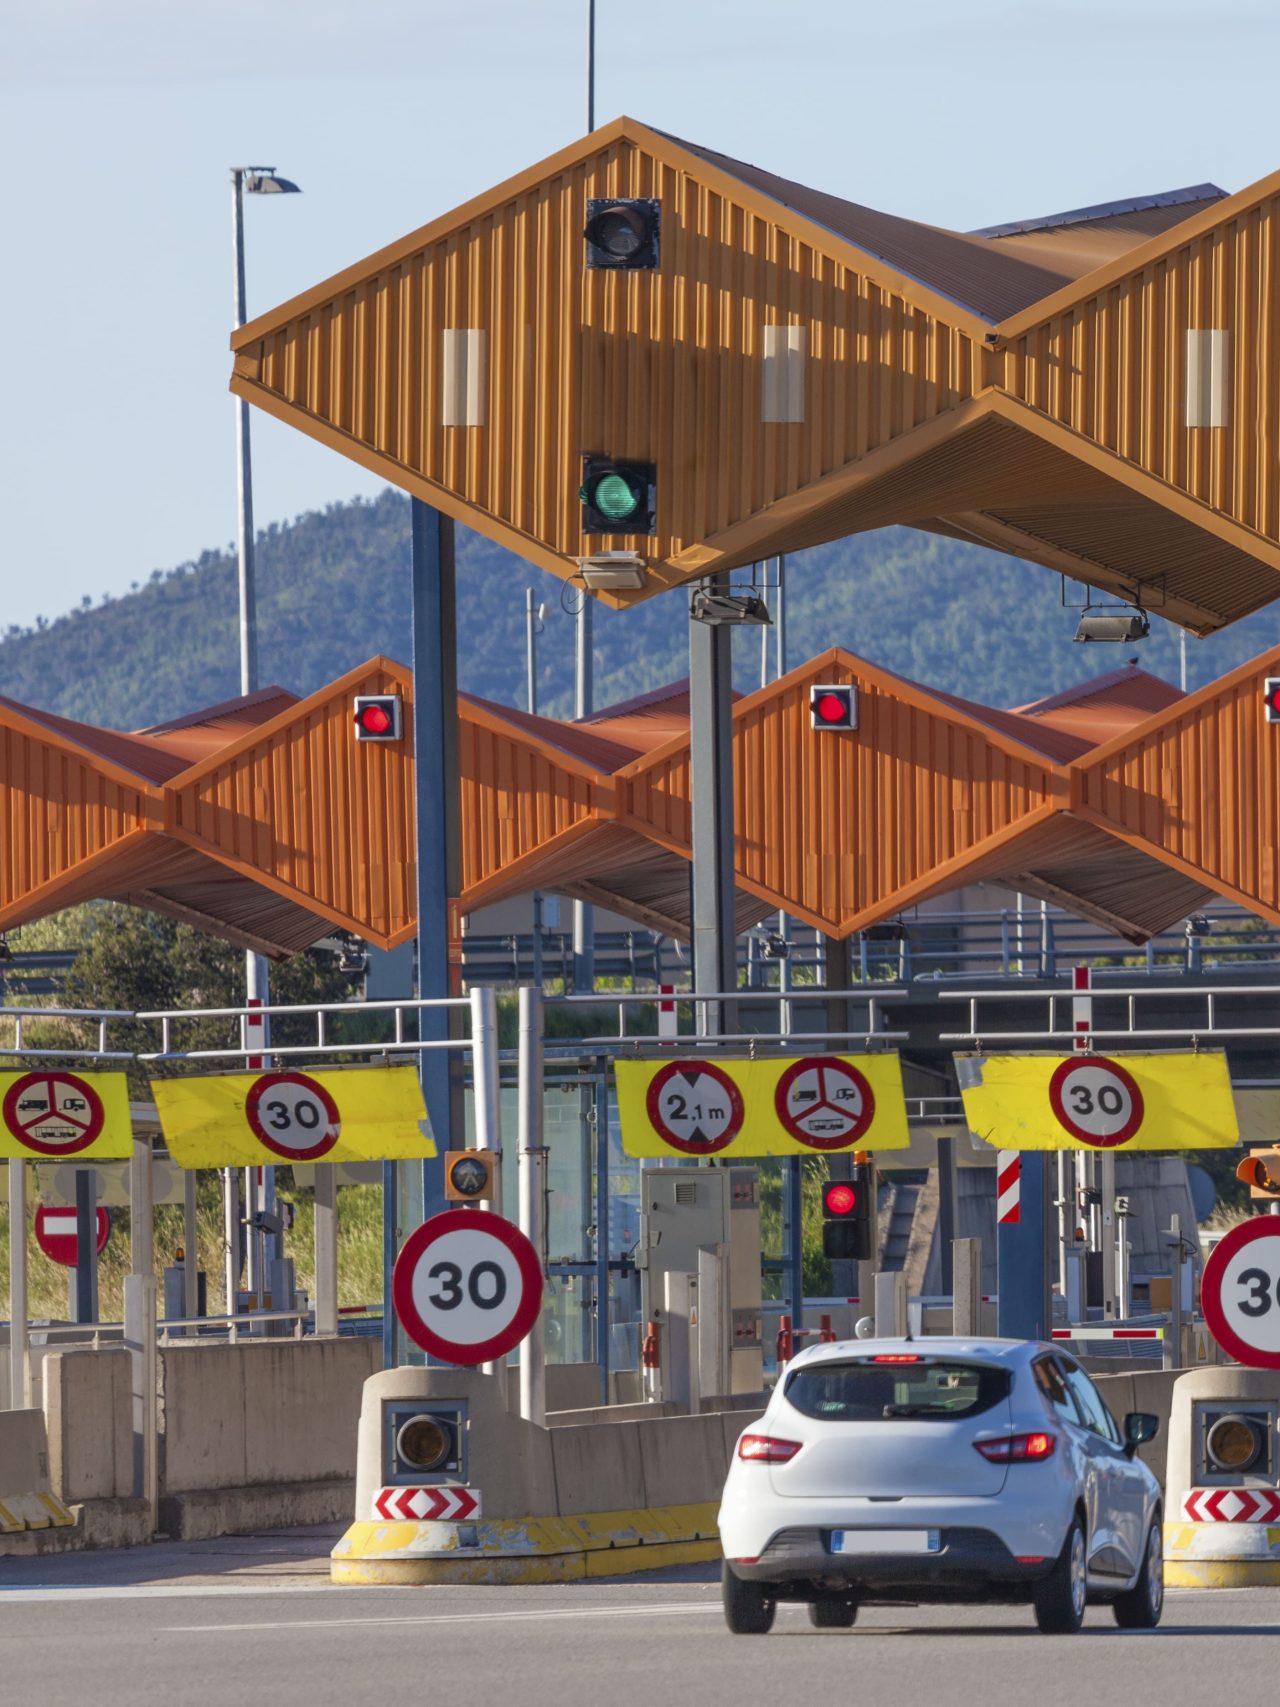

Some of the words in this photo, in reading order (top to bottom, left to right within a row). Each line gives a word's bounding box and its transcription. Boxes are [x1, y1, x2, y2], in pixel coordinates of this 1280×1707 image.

[266, 1099, 320, 1130] 30
[709, 1108, 725, 1119] m
[1069, 1085, 1124, 1116] 30
[428, 1261, 506, 1311] 30
